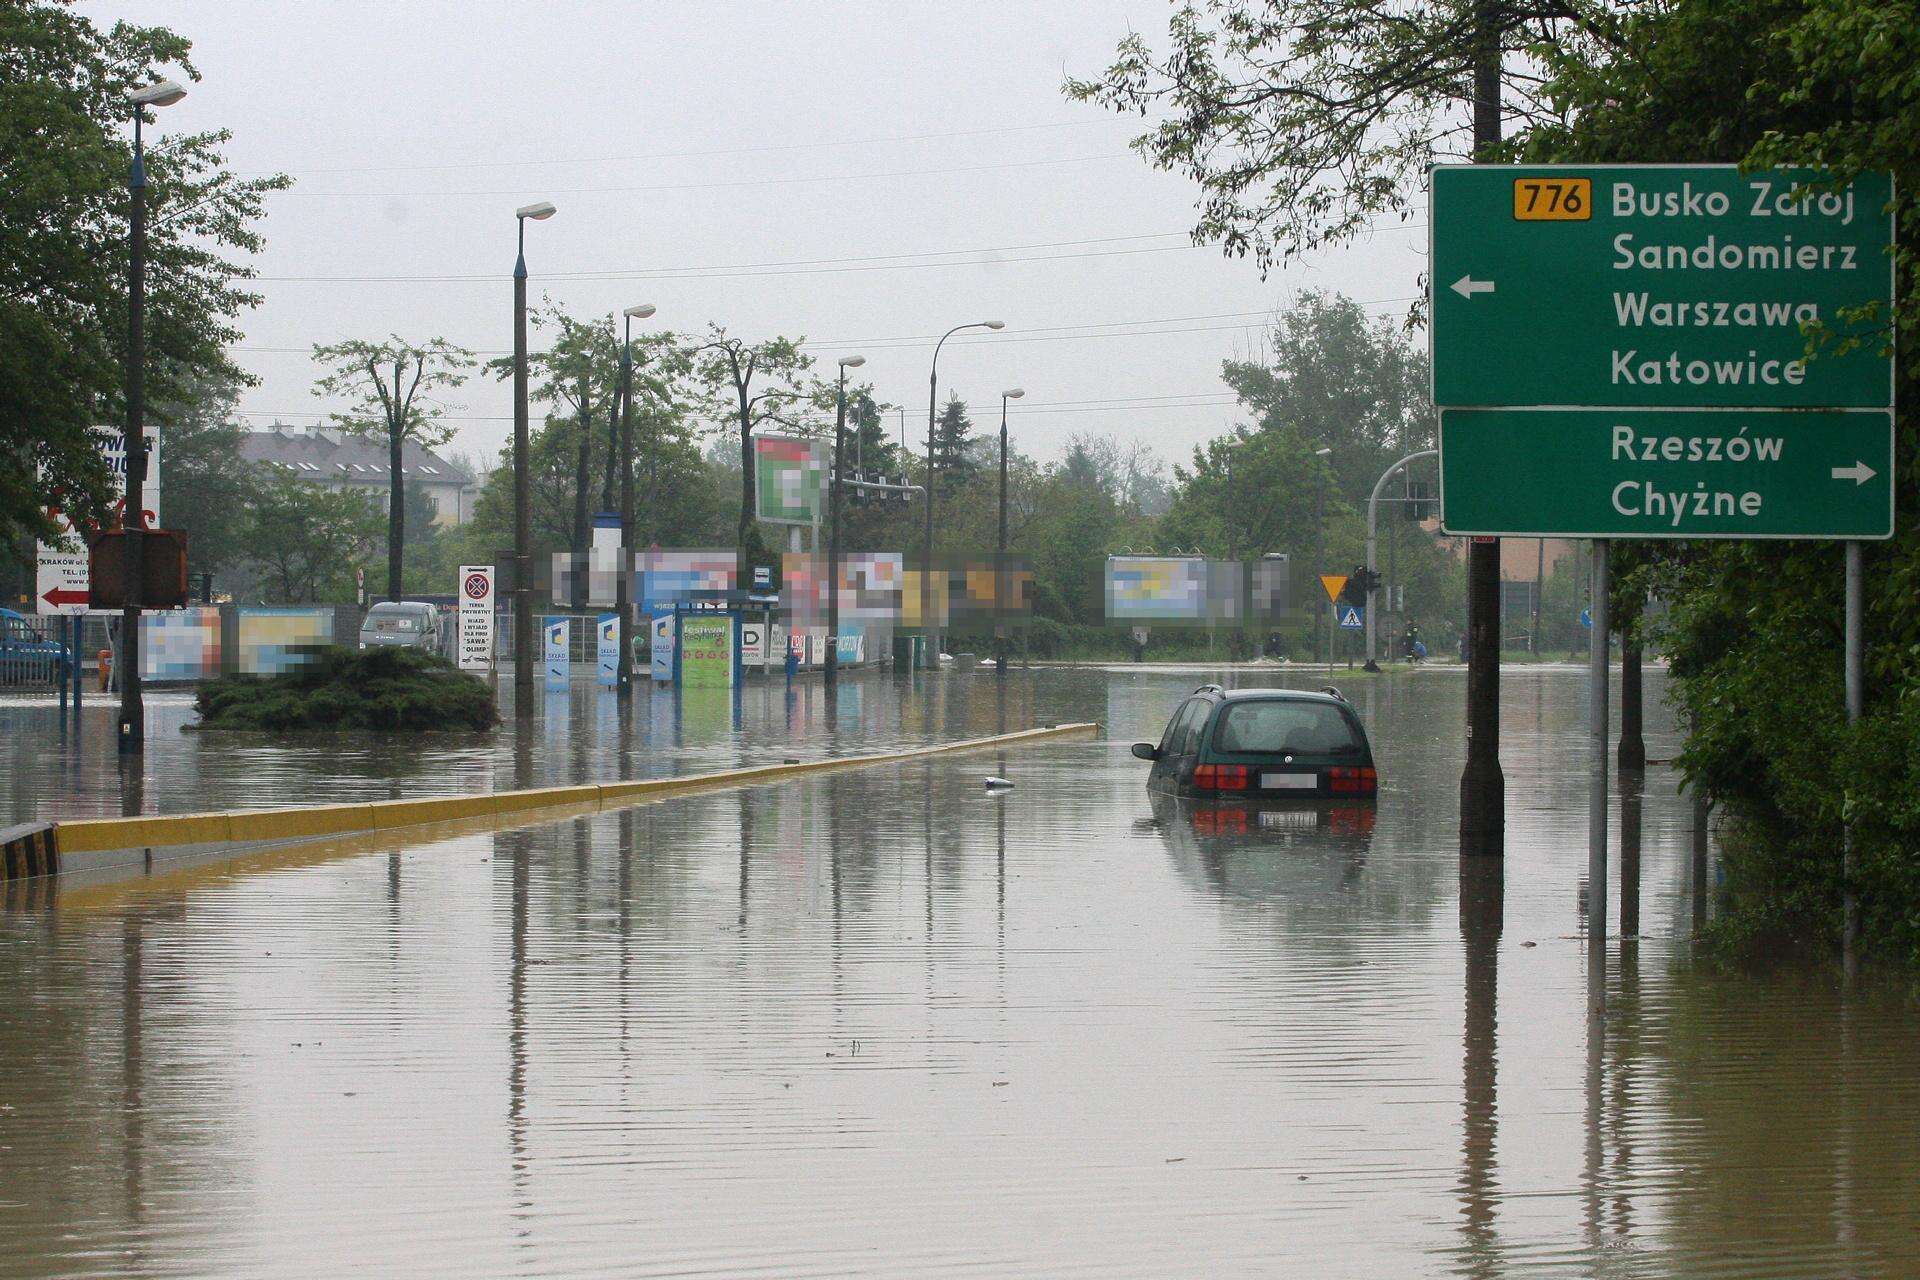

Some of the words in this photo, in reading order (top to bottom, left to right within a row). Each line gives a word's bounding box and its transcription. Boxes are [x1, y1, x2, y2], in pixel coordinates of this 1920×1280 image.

[1524, 185, 1582, 213] 776
[1612, 181, 1730, 217] Busko
[1612, 233, 1857, 270] Sandomierz
[1613, 292, 1818, 327] Warszawa
[1612, 350, 1806, 385] Katowice
[1612, 425, 1784, 462] Rzeszów
[1611, 480, 1763, 527] Chyżne
